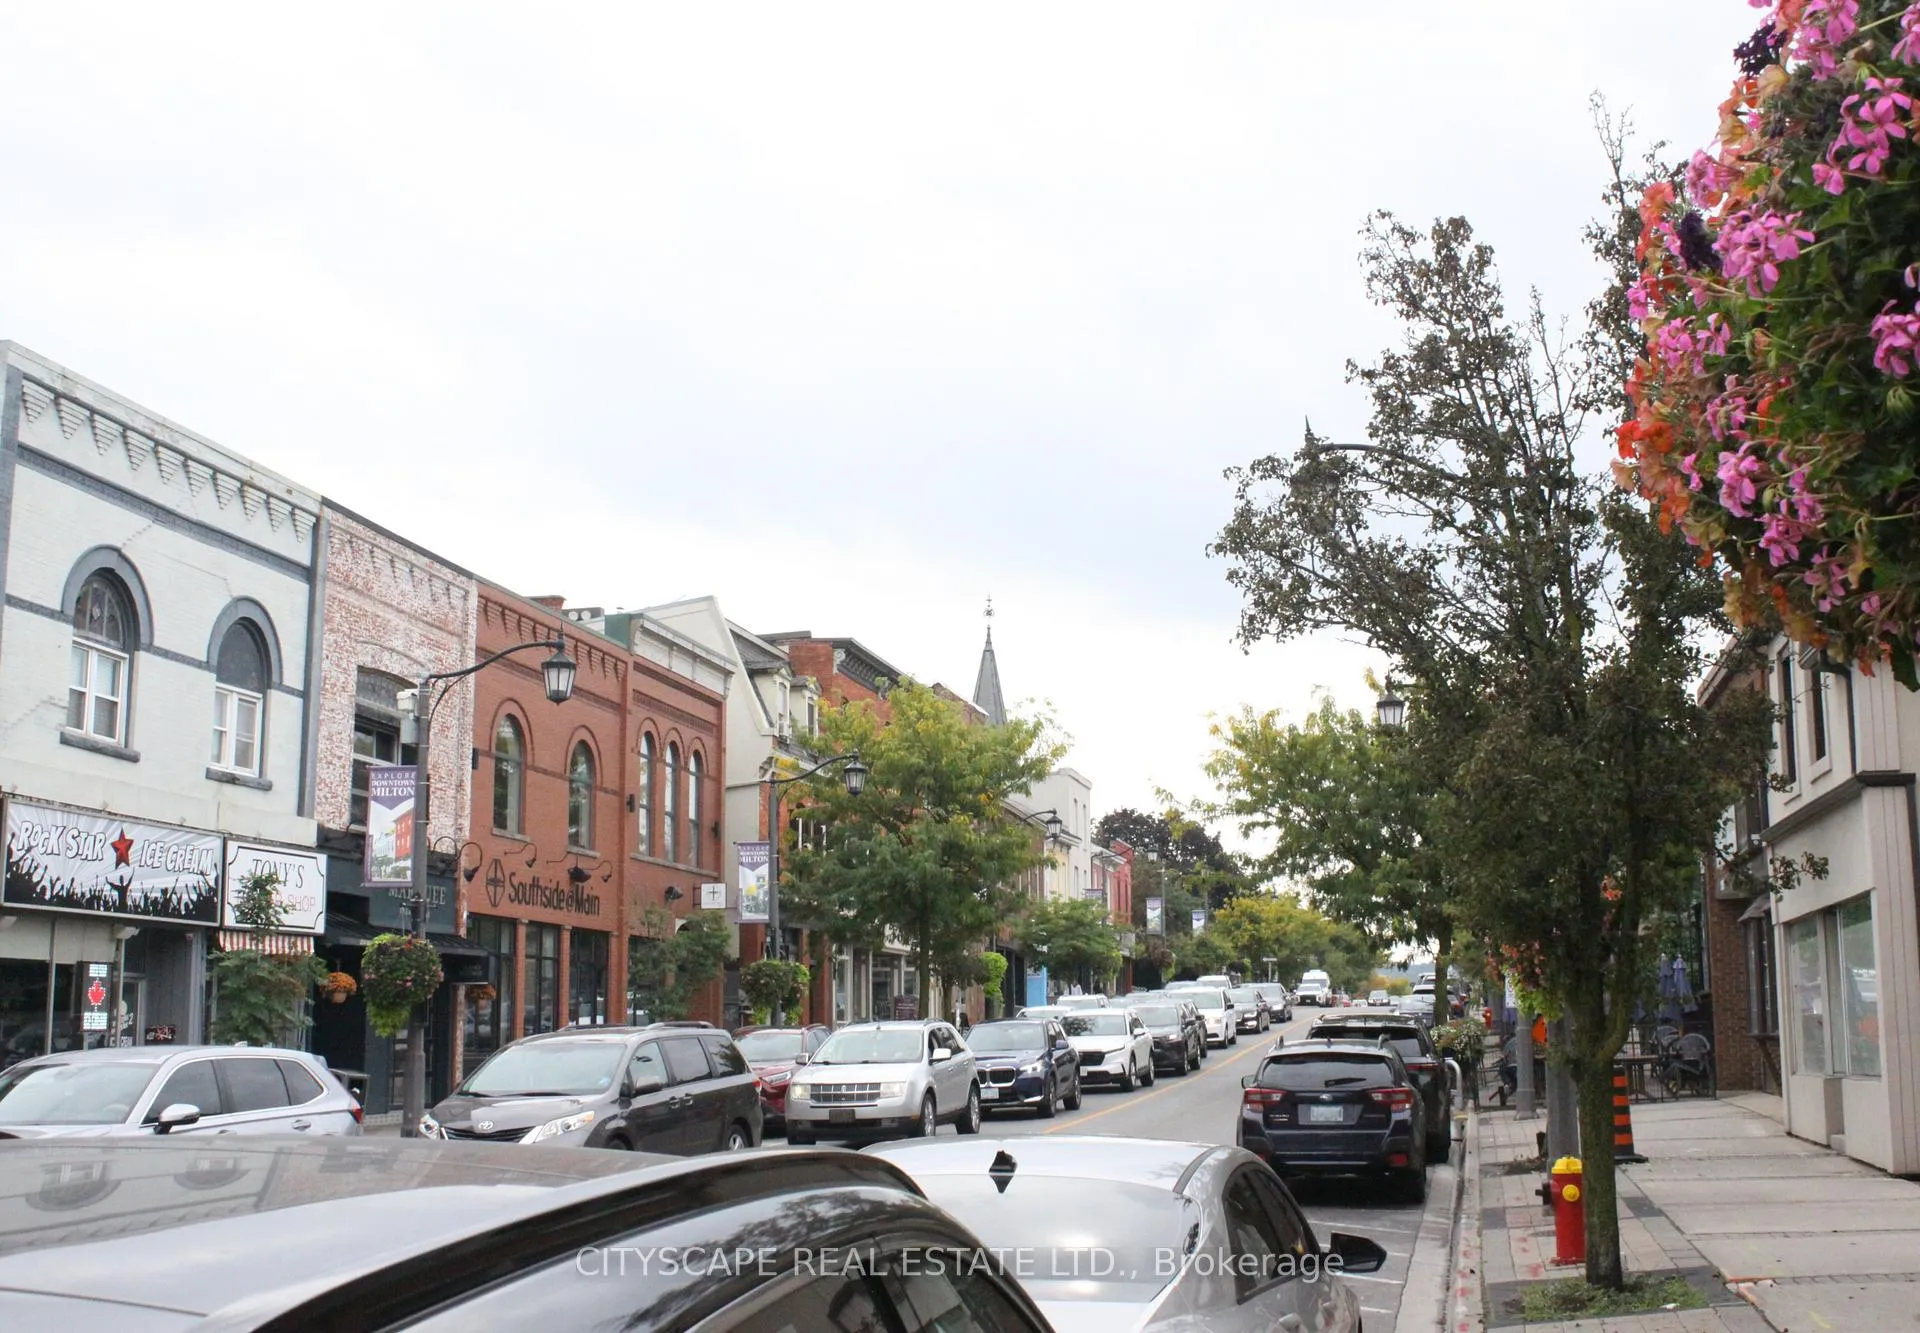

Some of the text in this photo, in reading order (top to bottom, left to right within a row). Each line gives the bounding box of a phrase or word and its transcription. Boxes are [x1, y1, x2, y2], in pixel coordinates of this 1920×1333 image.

[371, 771, 416, 779] EXPLORE
[370, 787, 415, 797] MILTON
[18, 821, 215, 876] ROCK STAR ICE CREAM
